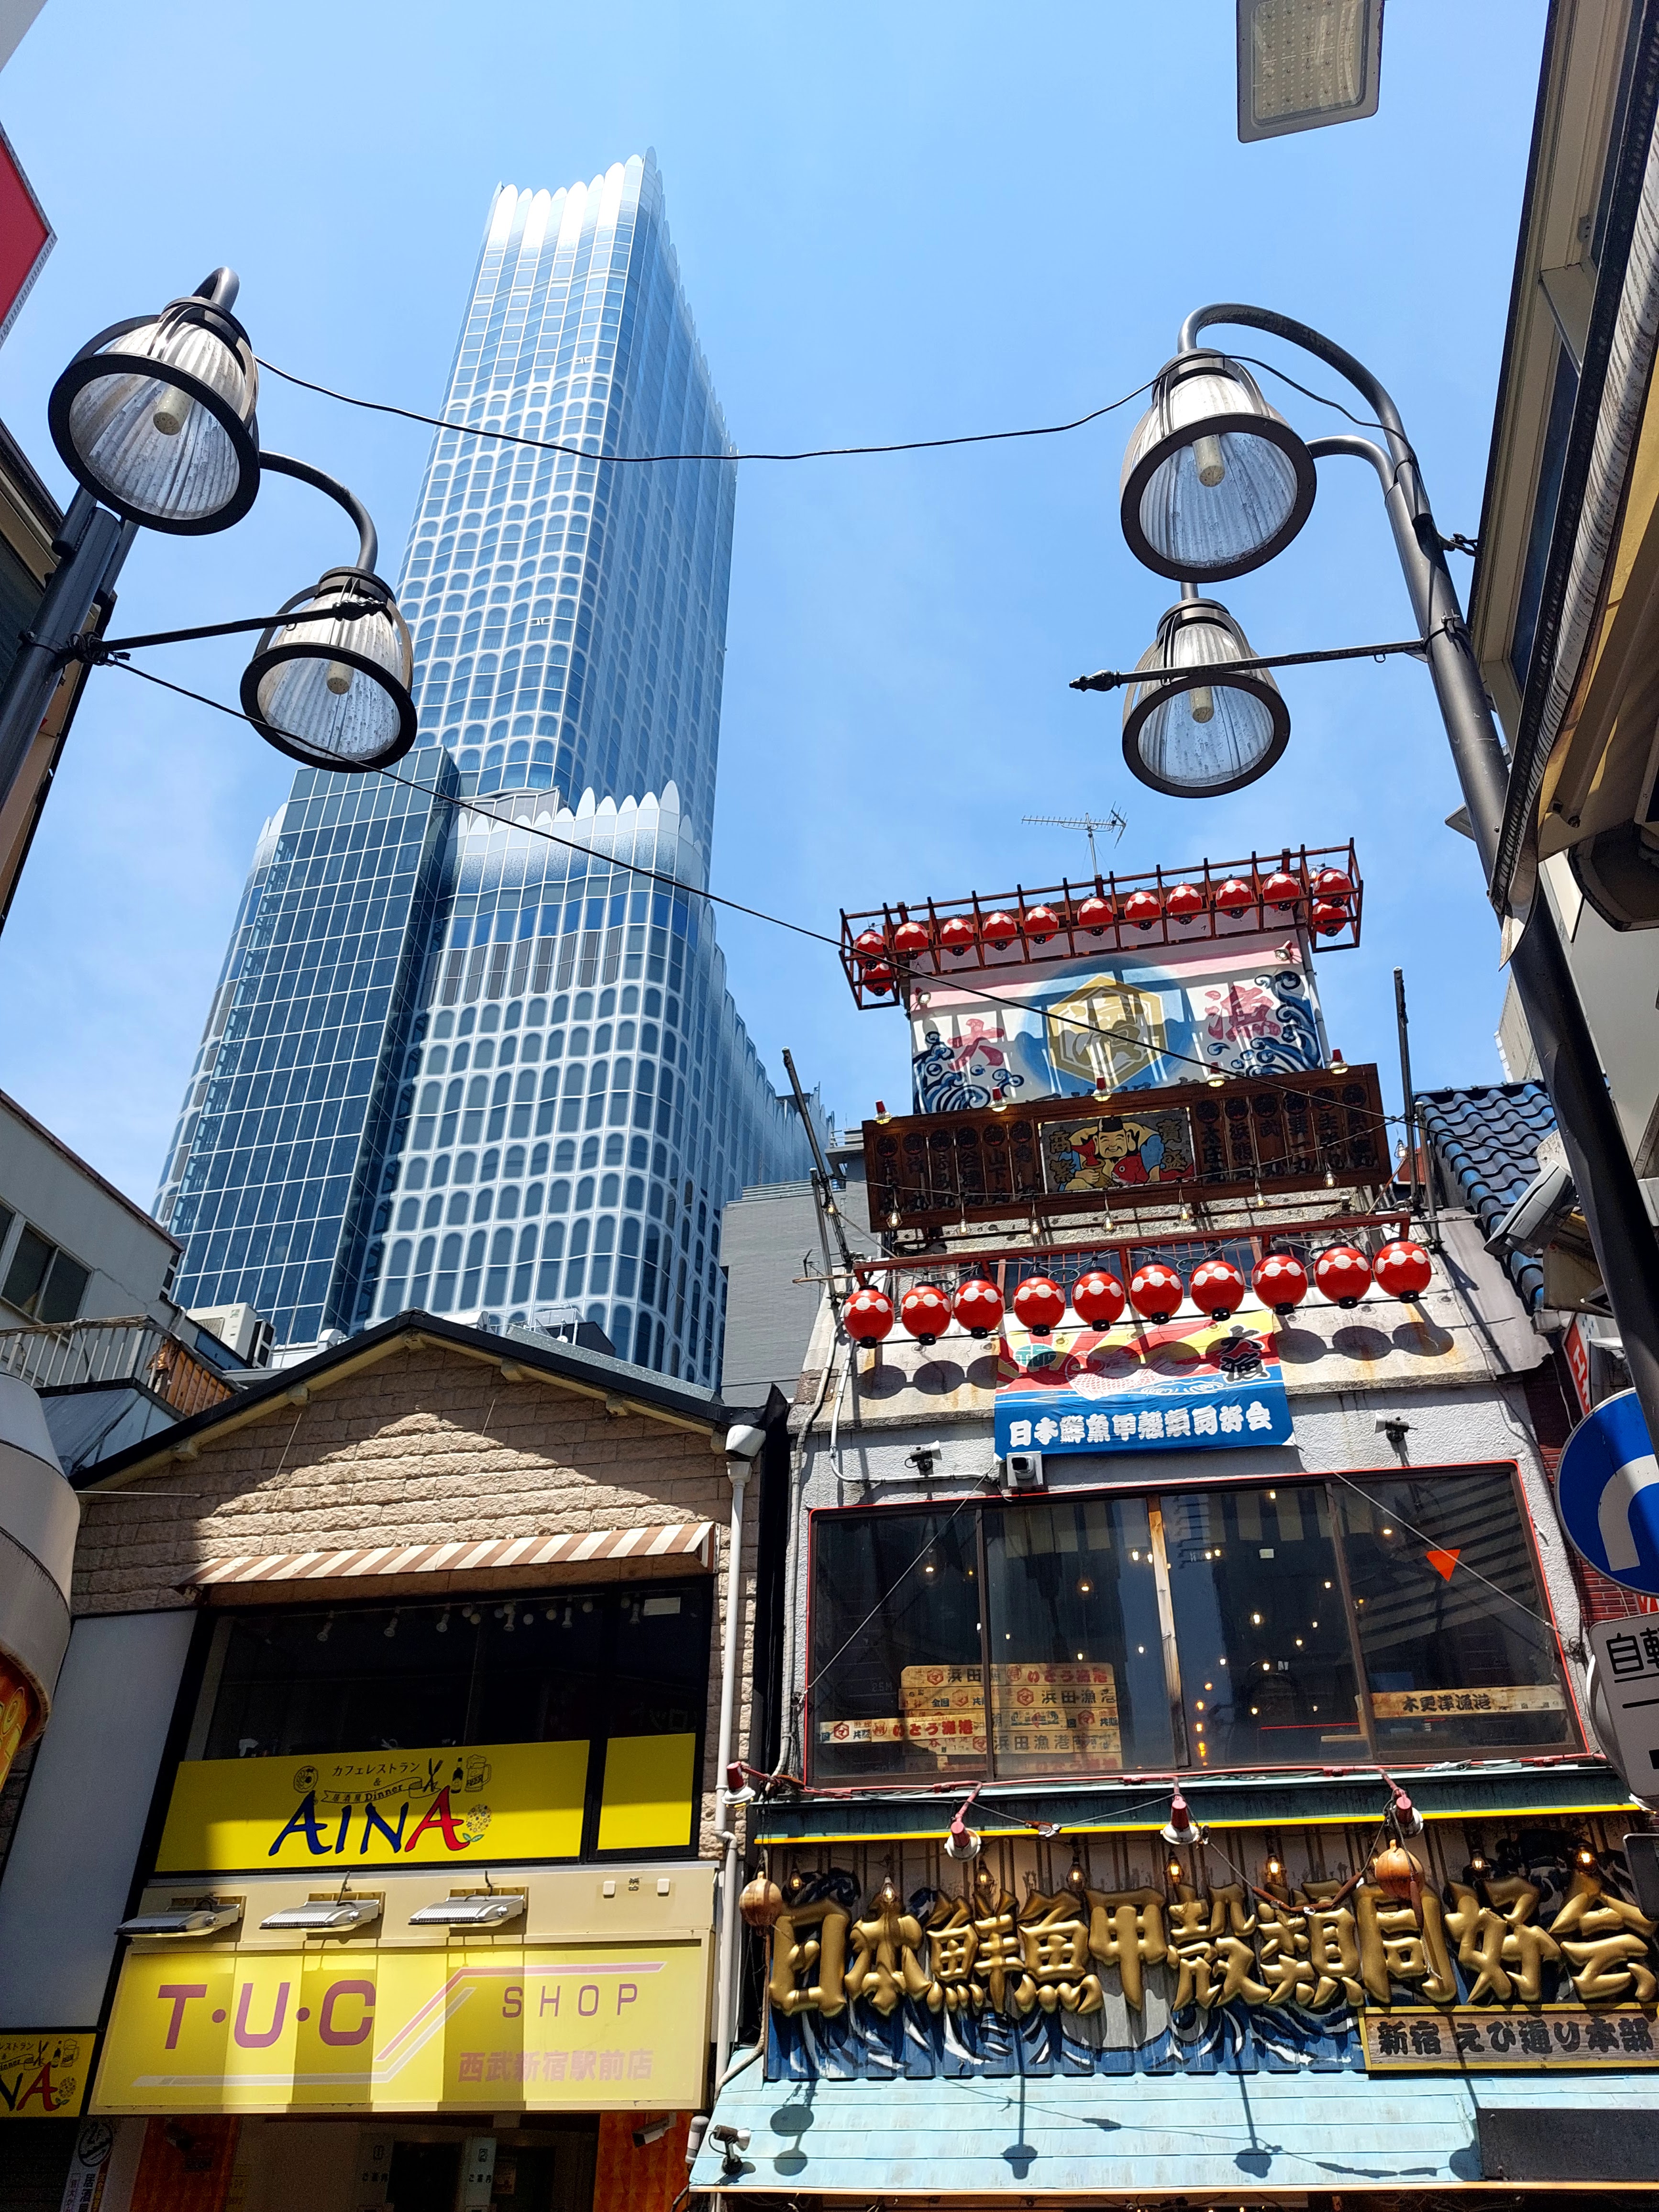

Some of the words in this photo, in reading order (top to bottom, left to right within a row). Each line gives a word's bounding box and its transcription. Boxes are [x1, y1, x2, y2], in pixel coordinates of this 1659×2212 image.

[947, 1018, 1005, 1072] 大
[1220, 1325, 1271, 1382] 大漁
[1403, 1693, 1492, 1713] 木更津漁港
[893, 1719, 973, 1737] いとう漁港
[994, 1735, 1070, 1750] 浜田漁港
[332, 1762, 420, 1777] カフェレストラン
[373, 1778, 381, 1786] &
[365, 1785, 403, 1802] Dinner
[269, 1785, 471, 1856] AINA
[502, 1983, 639, 2018] SHOP
[1378, 2020, 1441, 2056] 新宿
[1457, 2017, 1655, 2055] えび通り本部
[458, 2049, 654, 2082] 西武新宿駅前店
